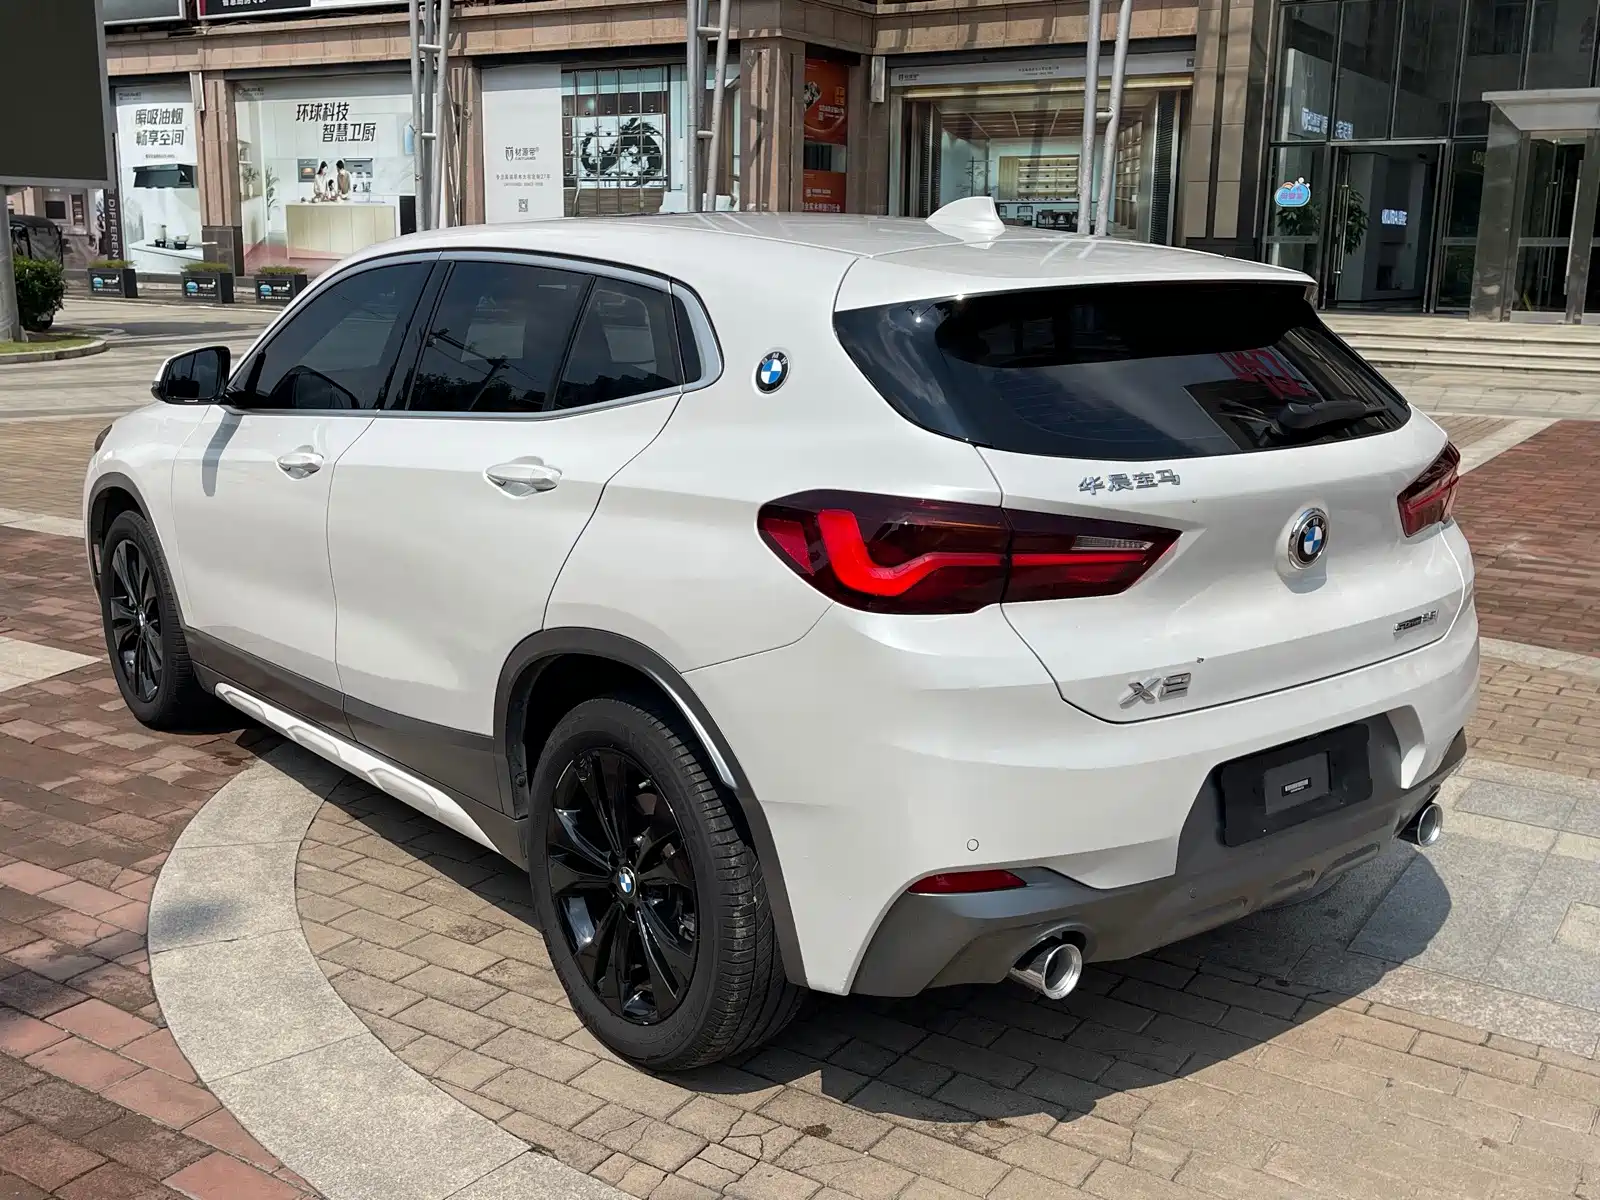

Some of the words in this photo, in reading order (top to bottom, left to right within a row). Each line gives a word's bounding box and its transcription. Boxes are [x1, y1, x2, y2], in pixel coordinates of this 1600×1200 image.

[135, 108, 184, 126] 瞬吸油烟
[296, 102, 350, 122] 环球科技
[136, 129, 185, 146] 畅享空间
[322, 122, 377, 142] 智慧卫厨
[1078, 469, 1180, 495] 华晨宝马
[1119, 672, 1191, 709] X2
